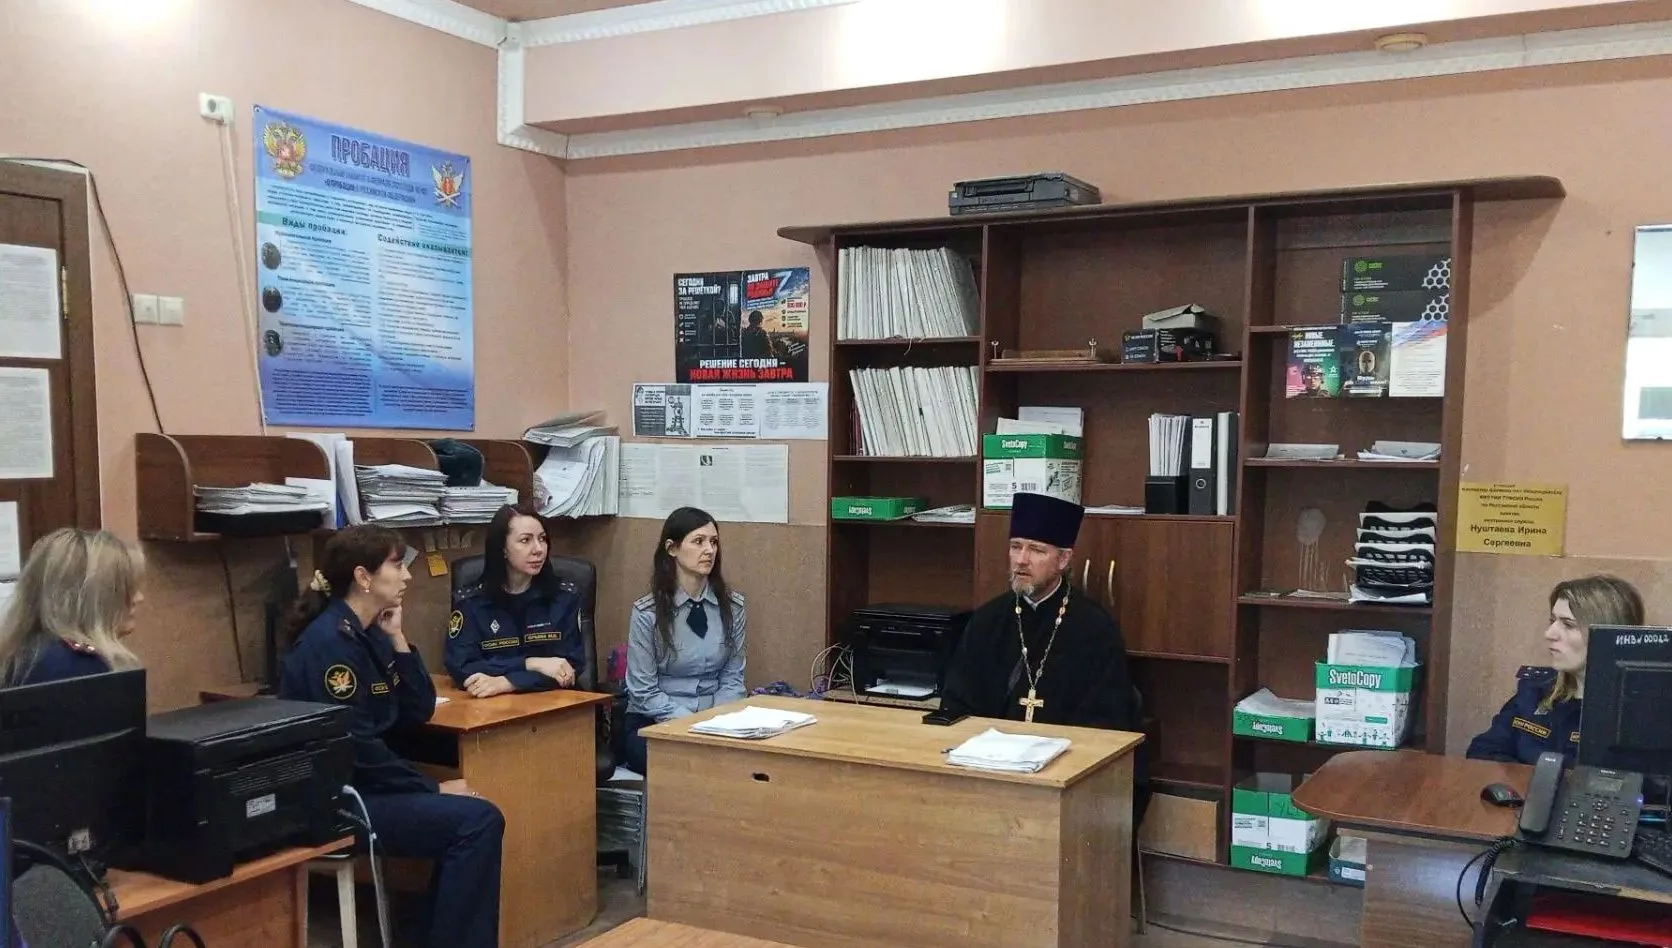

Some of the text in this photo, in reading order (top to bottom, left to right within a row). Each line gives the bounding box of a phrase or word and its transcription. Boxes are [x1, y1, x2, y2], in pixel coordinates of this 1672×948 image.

[331, 134, 411, 178] ПРОБАЦИЯ
[282, 216, 306, 229] Виды
[747, 271, 770, 283] ЗАВТРА
[677, 286, 688, 295] ЗА
[700, 358, 738, 369] РЕШЕНИЕ
[739, 358, 778, 368] СЕГОДНЯ
[690, 367, 794, 380] НОВАЯ ЖИЗНЬ ЗАВТРА
[1011, 482, 1017, 490] 5
[1470, 524, 1548, 535] Нуштаева Ирина
[1483, 538, 1532, 548] Сергеевна
[1329, 668, 1382, 689] SvetoCopy
